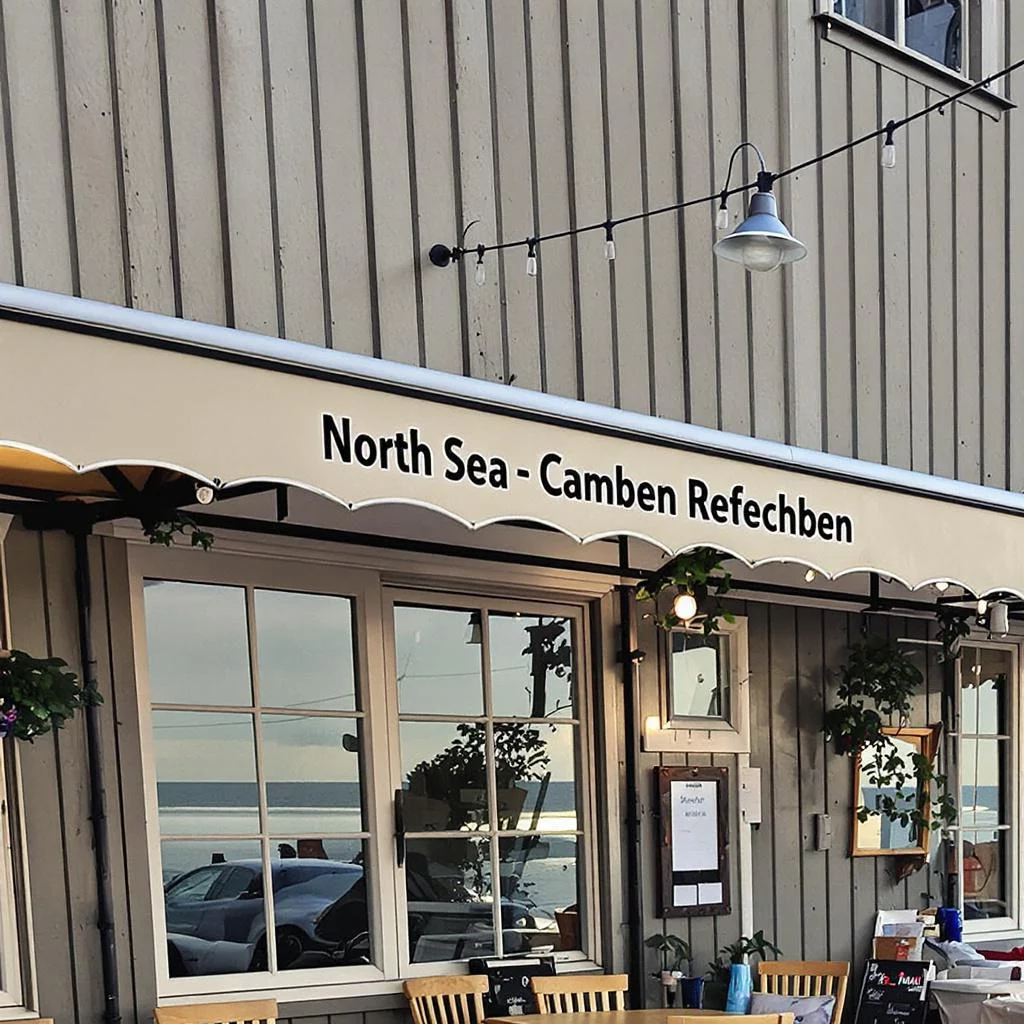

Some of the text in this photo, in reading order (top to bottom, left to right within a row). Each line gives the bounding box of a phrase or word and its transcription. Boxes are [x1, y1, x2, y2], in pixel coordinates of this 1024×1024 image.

[322, 413, 432, 477] North
[444, 435, 509, 490] Sea
[539, 452, 678, 517] Camben
[687, 478, 853, 543] Refechben
